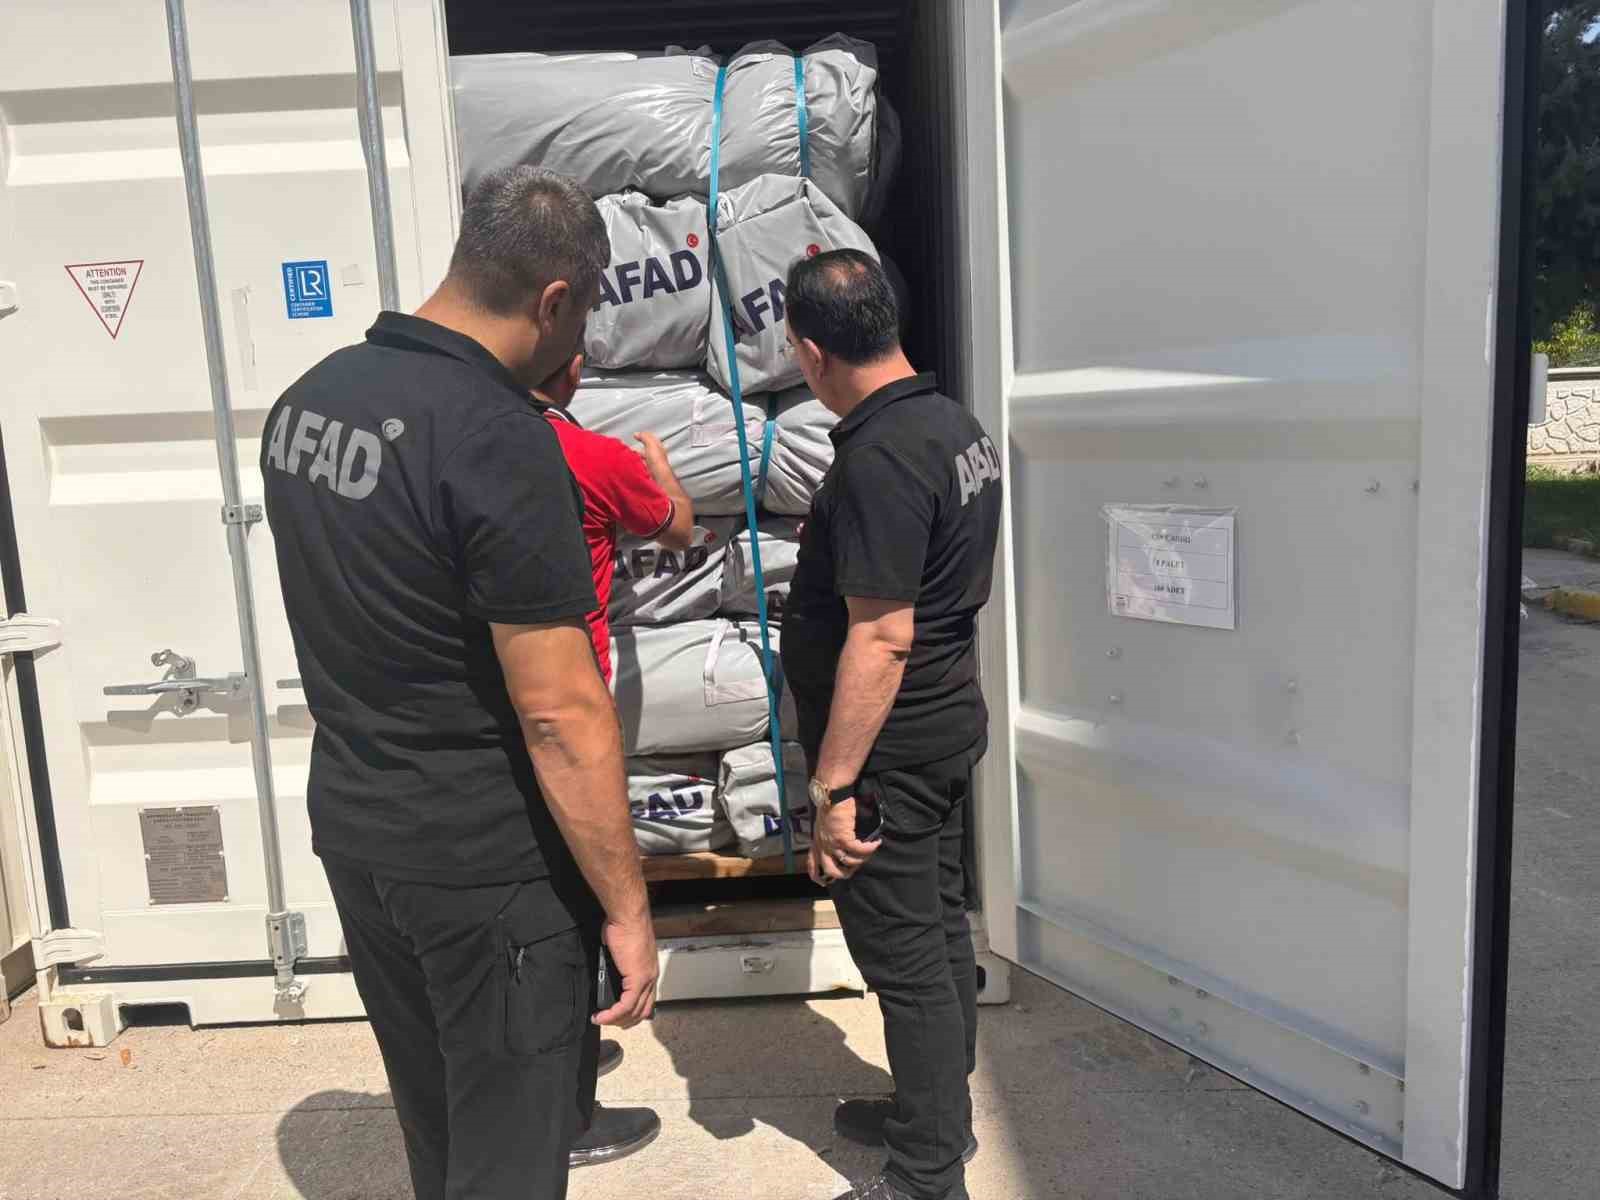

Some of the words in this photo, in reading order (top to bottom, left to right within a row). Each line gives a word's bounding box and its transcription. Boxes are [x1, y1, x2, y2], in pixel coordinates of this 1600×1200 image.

[86, 267, 127, 278] ATTENTION
[300, 270, 323, 296] LR
[592, 249, 702, 312] AFAD
[267, 405, 382, 500] AFAD
[954, 436, 1001, 507] AFAD
